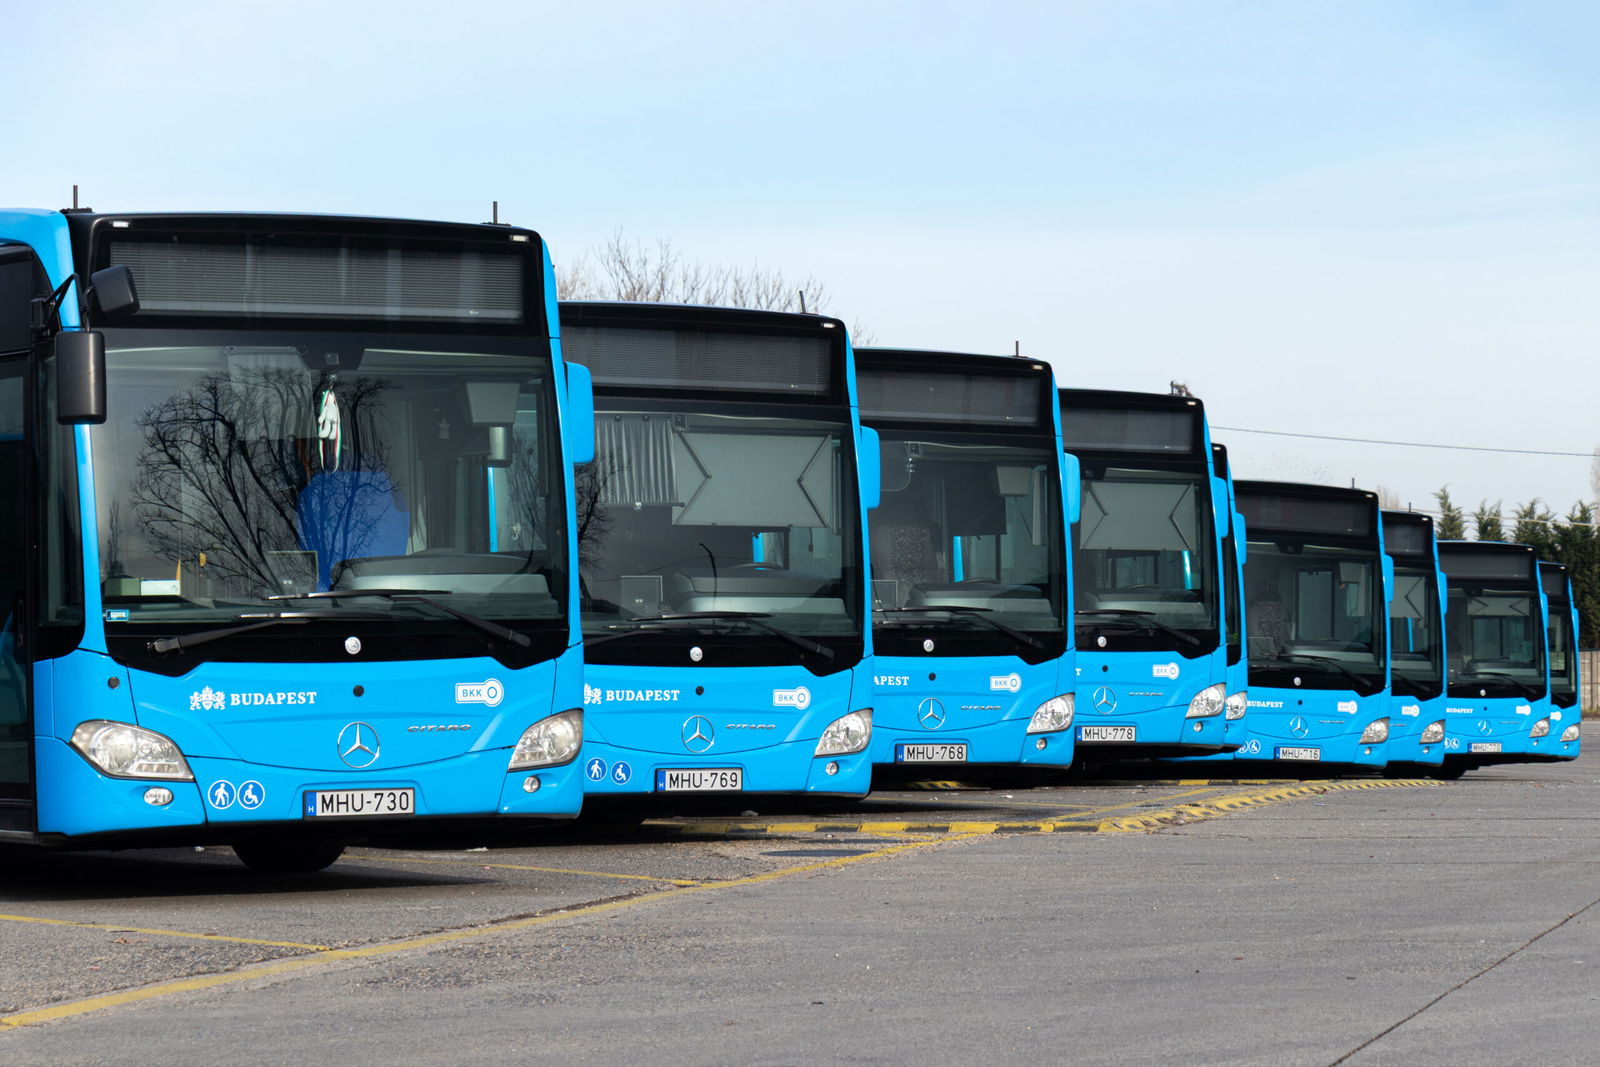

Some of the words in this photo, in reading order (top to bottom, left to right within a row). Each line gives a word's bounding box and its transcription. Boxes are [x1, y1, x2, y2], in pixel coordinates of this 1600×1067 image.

[230, 691, 317, 706] BUDAPEST
[462, 688, 482, 698] BKK
[605, 689, 680, 702] BUDAPEST
[778, 694, 794, 702] BKK
[1246, 700, 1284, 708] BUDAPEST
[407, 724, 472, 733] CITARO
[1084, 728, 1133, 740] MHU-778
[906, 746, 964, 760] MHU-768
[1281, 749, 1319, 759] MHU-716
[669, 772, 738, 789] MHU-769
[321, 791, 409, 813] MHU-730
